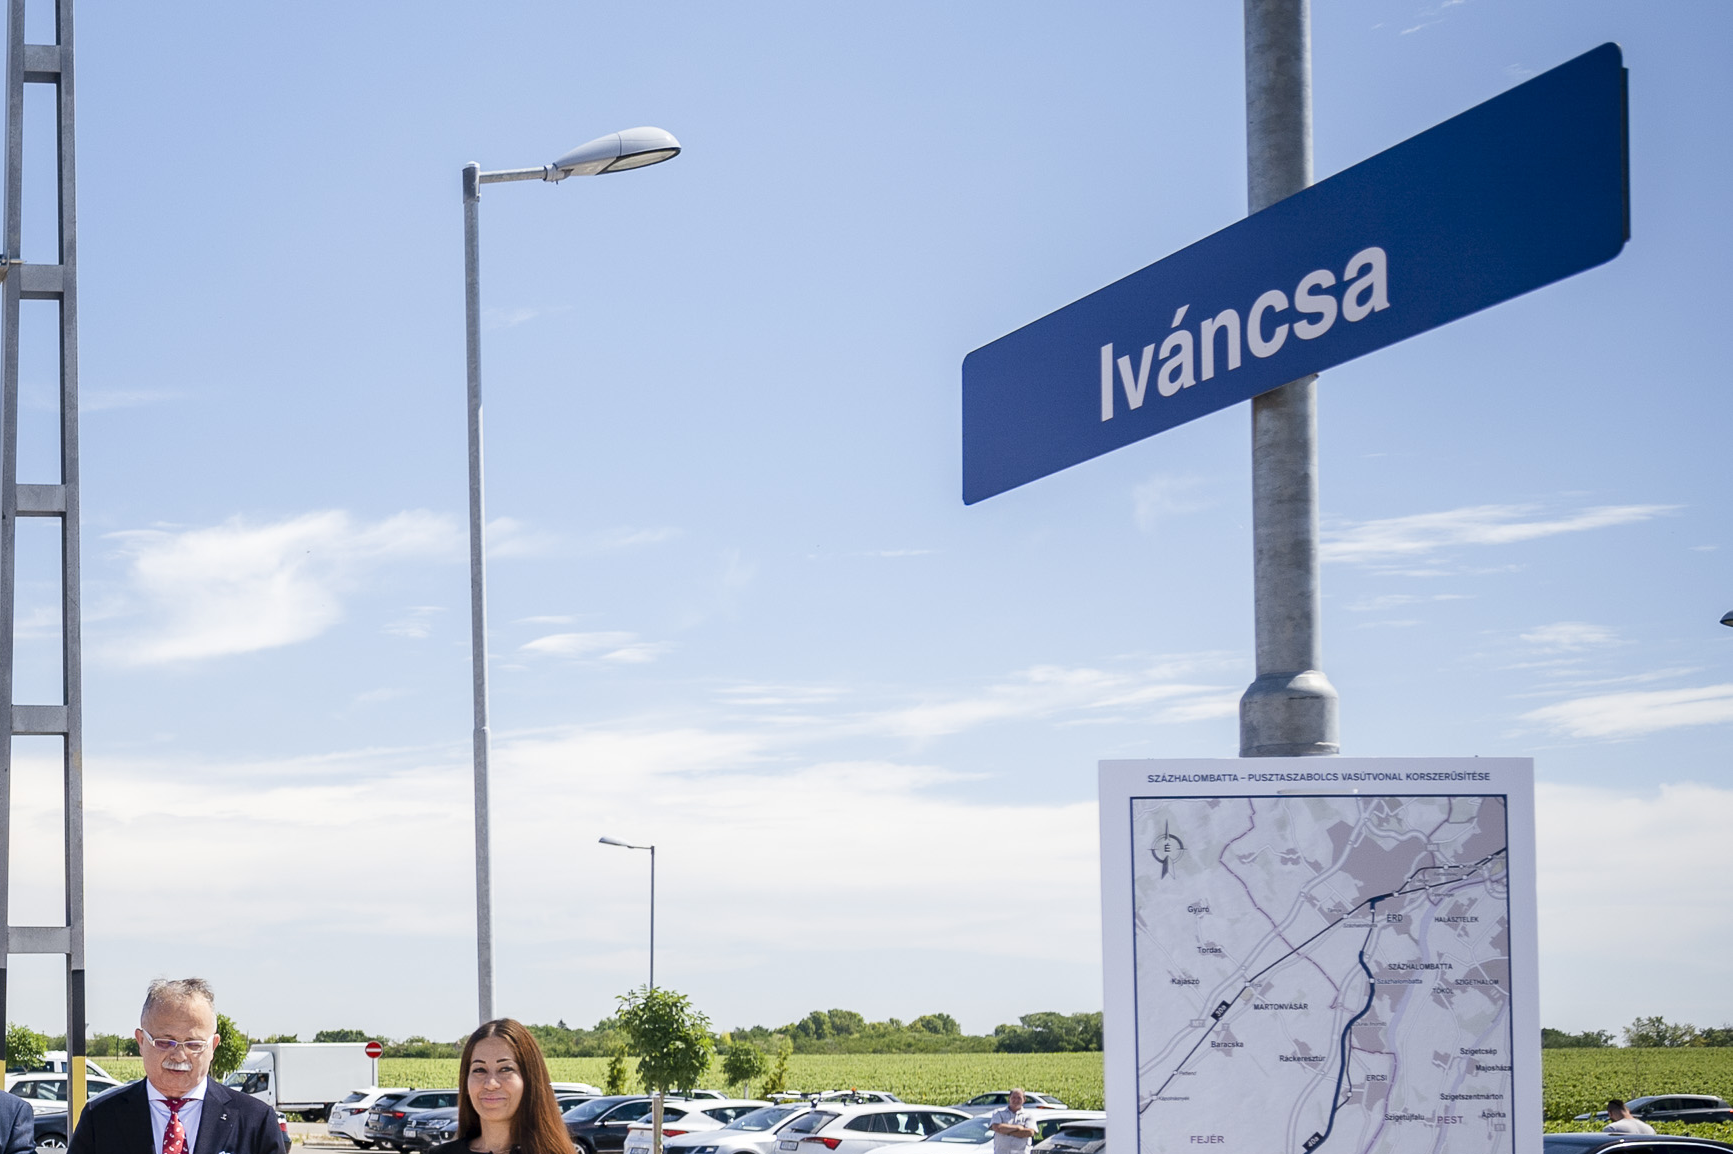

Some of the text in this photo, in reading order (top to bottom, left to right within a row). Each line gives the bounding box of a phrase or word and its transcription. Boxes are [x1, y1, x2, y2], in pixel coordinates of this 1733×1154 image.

[1100, 246, 1391, 422] Iváncsa
[1147, 772, 1239, 783] SZÁZHALOMBATTA
[1248, 772, 1339, 782] PUSZTASZABOLCS
[1341, 770, 1403, 781] VASÚTVONAL
[1406, 770, 1491, 781] KORSZERŰSÍTÉSE
[1197, 946, 1222, 954] Tordas
[1388, 962, 1454, 970] SZÁZHALOMBATTA
[1459, 1047, 1497, 1056] Szigetcsép
[1439, 1093, 1504, 1101] Szigetszentmárton
[1437, 1116, 1464, 1124] PEST
[1190, 1133, 1225, 1143] FEJÉR
